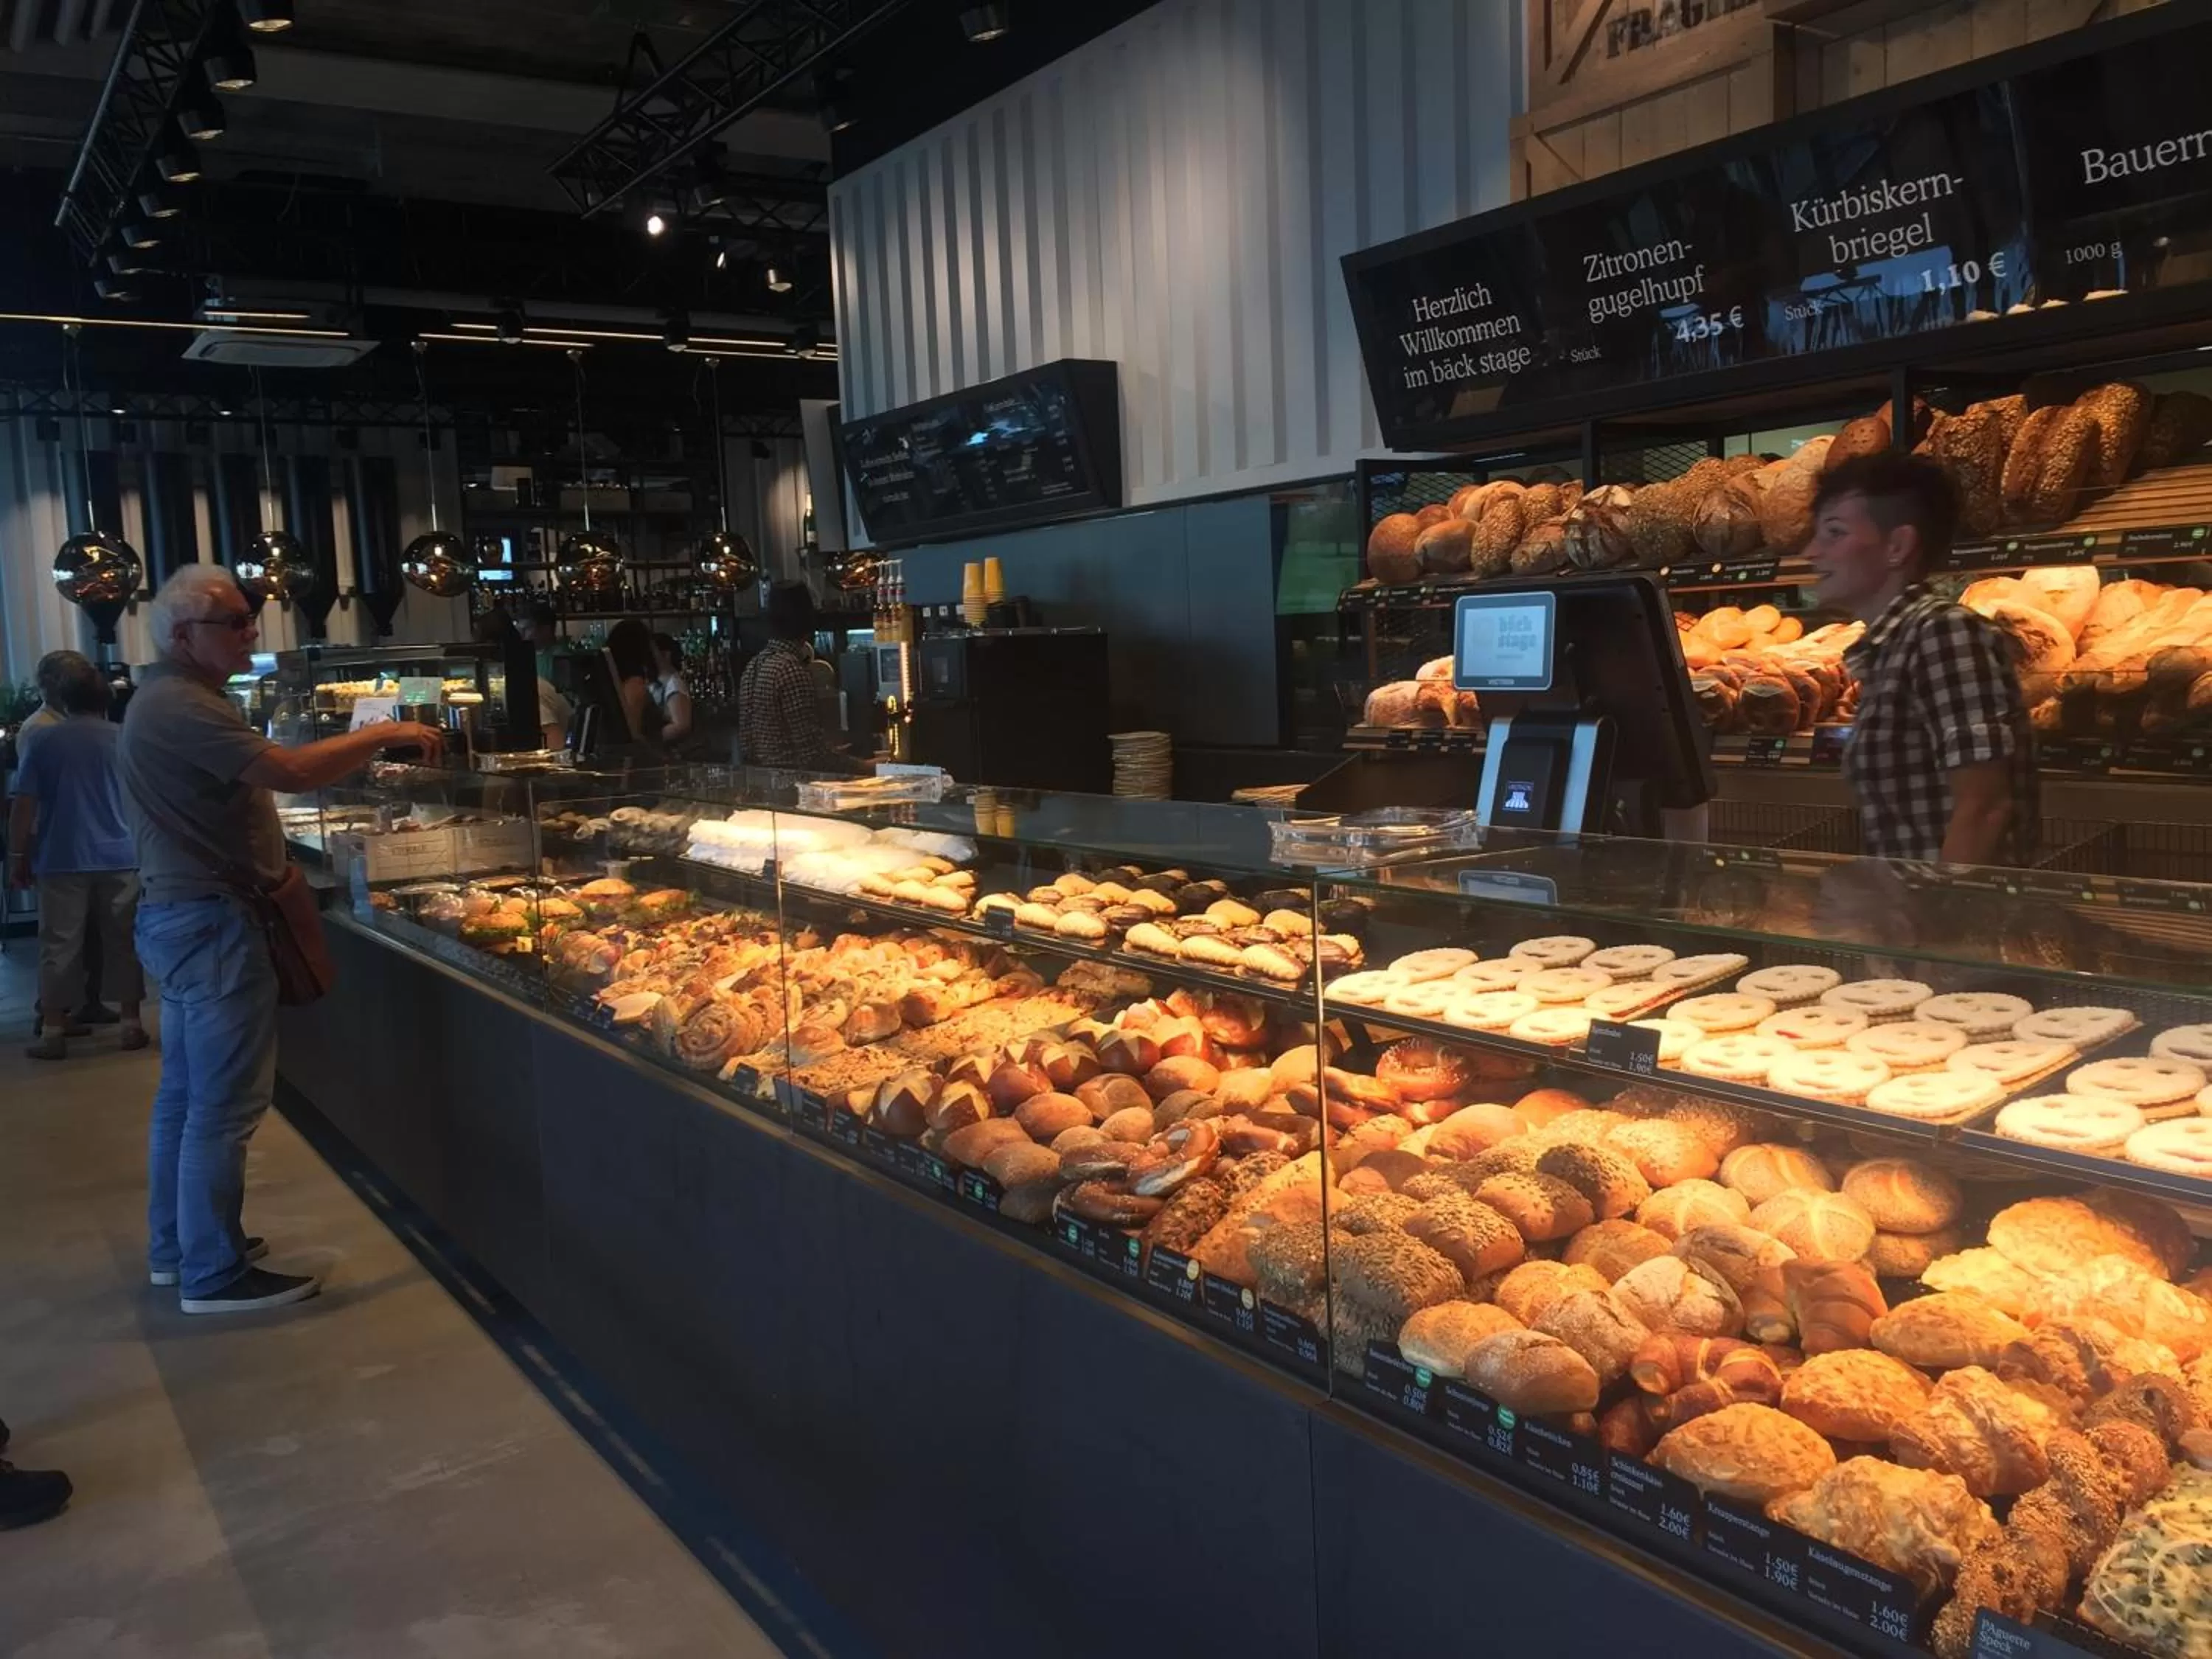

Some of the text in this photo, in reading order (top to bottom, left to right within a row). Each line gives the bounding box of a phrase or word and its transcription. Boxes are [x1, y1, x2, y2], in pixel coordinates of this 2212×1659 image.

[1790, 172, 1964, 232] Kürbiskern-
[1828, 211, 1935, 263] briegel
[2065, 240, 2124, 265] 1000 g
[1583, 238, 1694, 283] Zitronen-
[1921, 251, 2008, 296] 1,10 €
[1412, 282, 1492, 322] Herzlich
[1587, 265, 1705, 324] gugelhupf
[1399, 313, 1521, 357] Willkommen
[1674, 305, 1745, 344] 4,35 €
[1403, 345, 1531, 389] im bäck stage
[1570, 345, 1602, 364] Stück
[1869, 1615, 1910, 1642] 2.00€
